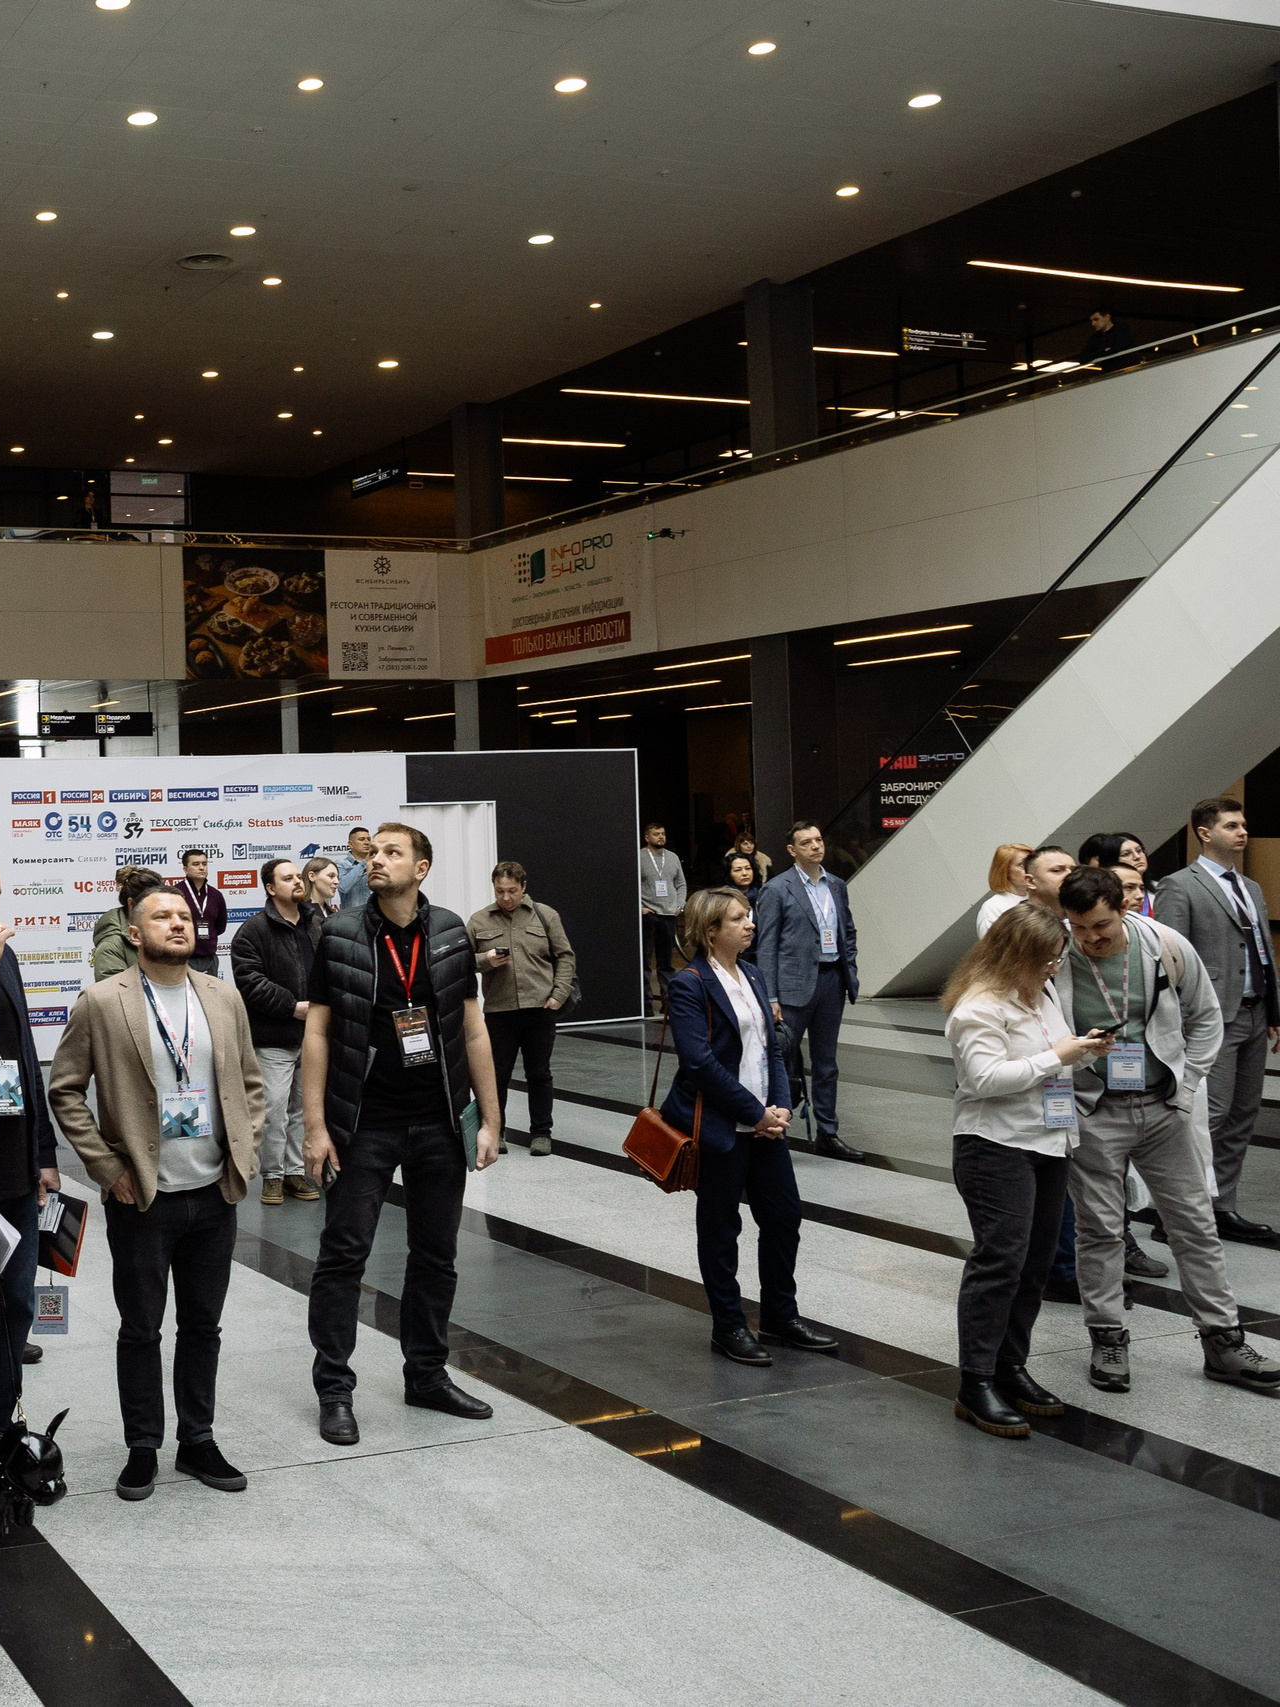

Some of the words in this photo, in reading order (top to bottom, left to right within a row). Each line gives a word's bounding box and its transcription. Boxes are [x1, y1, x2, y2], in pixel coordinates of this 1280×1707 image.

[550, 533, 613, 561] INFOPRO
[551, 555, 595, 578] 54.RU
[330, 601, 369, 610] РЕСТОРАН
[370, 601, 436, 611] ТРАДИЦИОННОЙ
[350, 613, 357, 621] И
[358, 612, 418, 622] СОВРЕМЕННОЙ
[511, 609, 551, 629] достоверный
[552, 604, 581, 621] источник
[582, 597, 624, 616] информации
[355, 625, 381, 633] КУХНИ
[382, 625, 414, 633] СИБИРИ
[512, 633, 544, 656] ТОЛЬКО
[545, 626, 582, 650] ВАЖНЫЕ
[583, 619, 625, 644] НОВОСТИ
[919, 752, 965, 762] ЭКСПО
[111, 791, 147, 800] СИБИРЬ
[151, 791, 162, 800] 24
[168, 790, 219, 800] ВЕСТИНСК.РФ
[326, 786, 350, 796] МИР
[45, 792, 53, 803] 1
[92, 792, 104, 801] 24
[881, 796, 895, 805] НА
[150, 818, 199, 827] ТЕХСОВЕТ
[248, 818, 284, 828] Status
[288, 813, 363, 823] status-media.com
[13, 820, 39, 828] МАЯК
[68, 815, 92, 833] 54
[203, 818, 243, 831] Сиб.фм
[115, 846, 168, 854] ПРОМЫШЛЕННИК
[248, 843, 292, 851] Промышленные
[12, 857, 75, 865] Коммерсантъ
[115, 853, 168, 866] СИБИРИ
[248, 852, 275, 861] страницы
[12, 886, 64, 896] ФОТОНИКА
[74, 881, 94, 893] ЧС
[14, 915, 61, 926] РИТМ
[23, 978, 82, 988] ектротехнический
